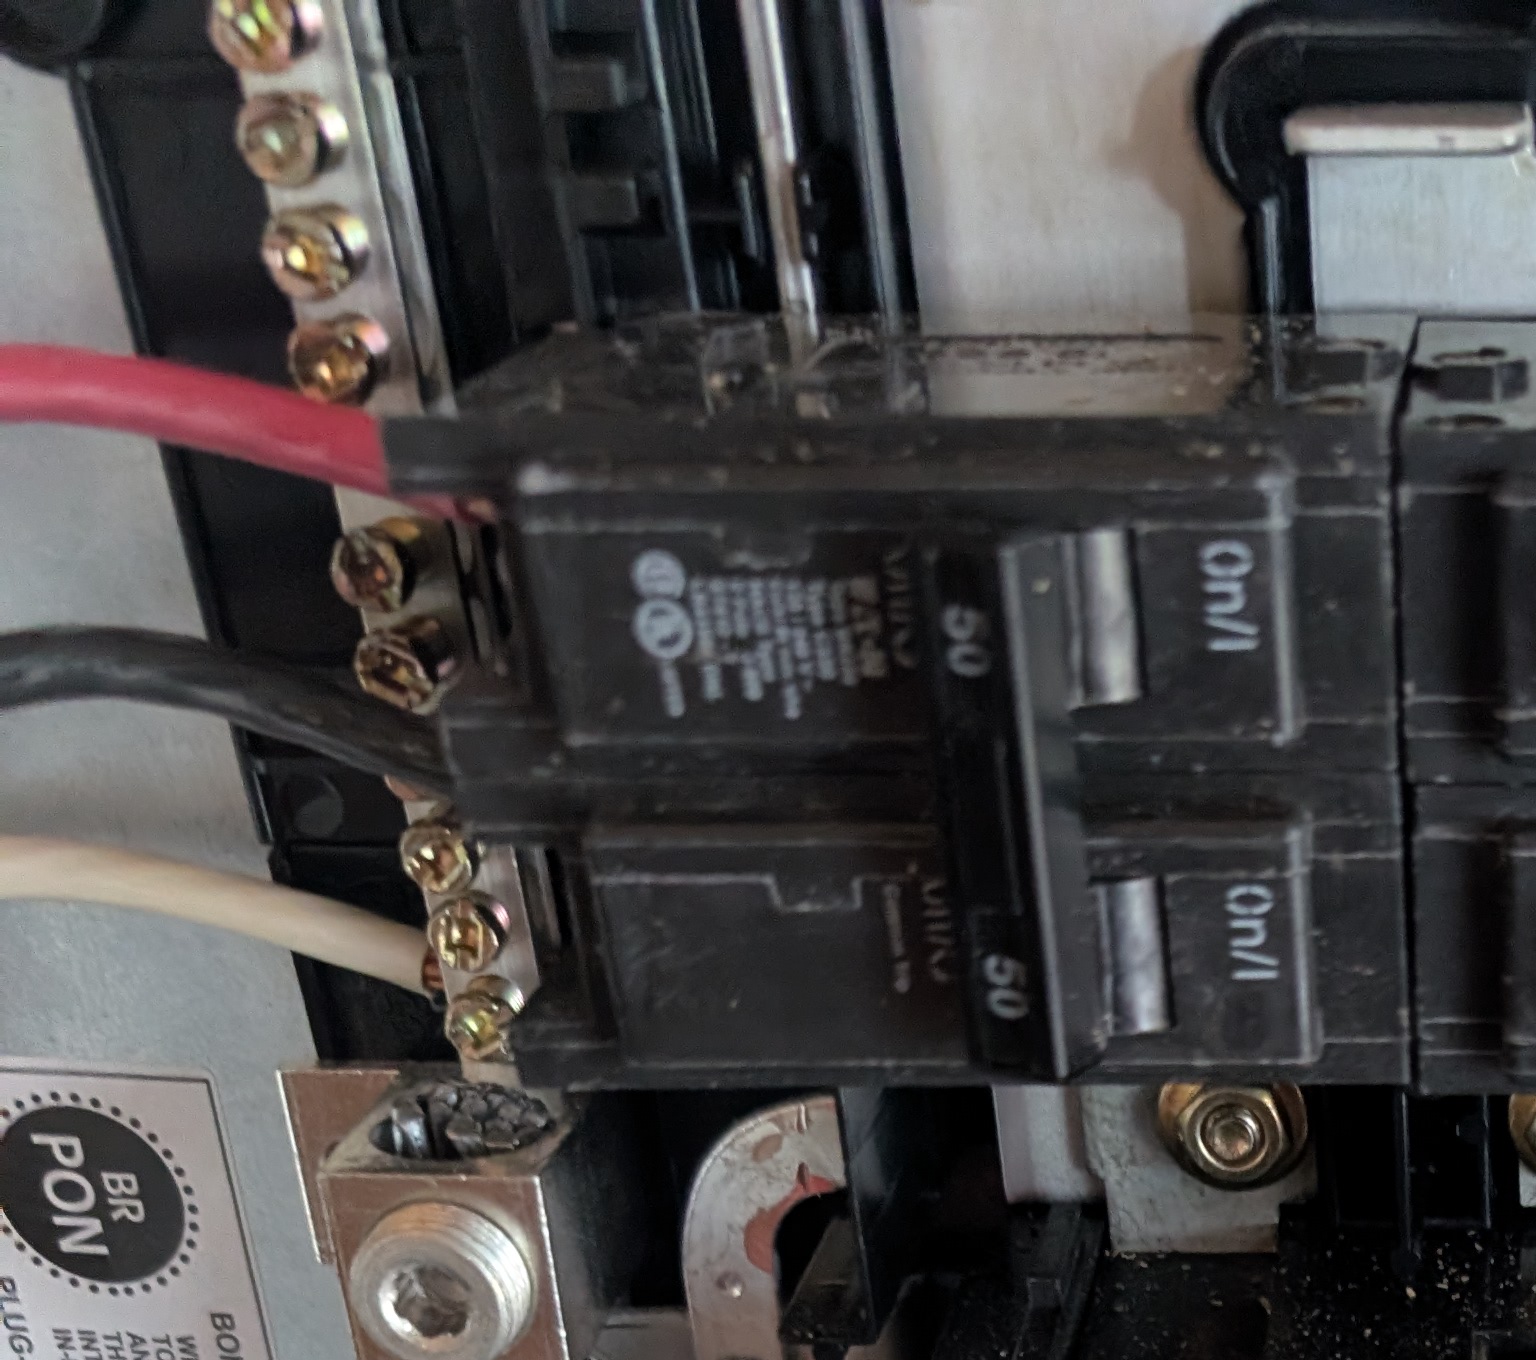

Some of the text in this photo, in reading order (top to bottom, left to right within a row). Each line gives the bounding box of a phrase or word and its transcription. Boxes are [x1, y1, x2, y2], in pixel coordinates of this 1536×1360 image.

[941, 604, 992, 678] 50
[982, 953, 1029, 1020] 50
[30, 1132, 110, 1256] PON
[101, 1172, 146, 1223] BR
